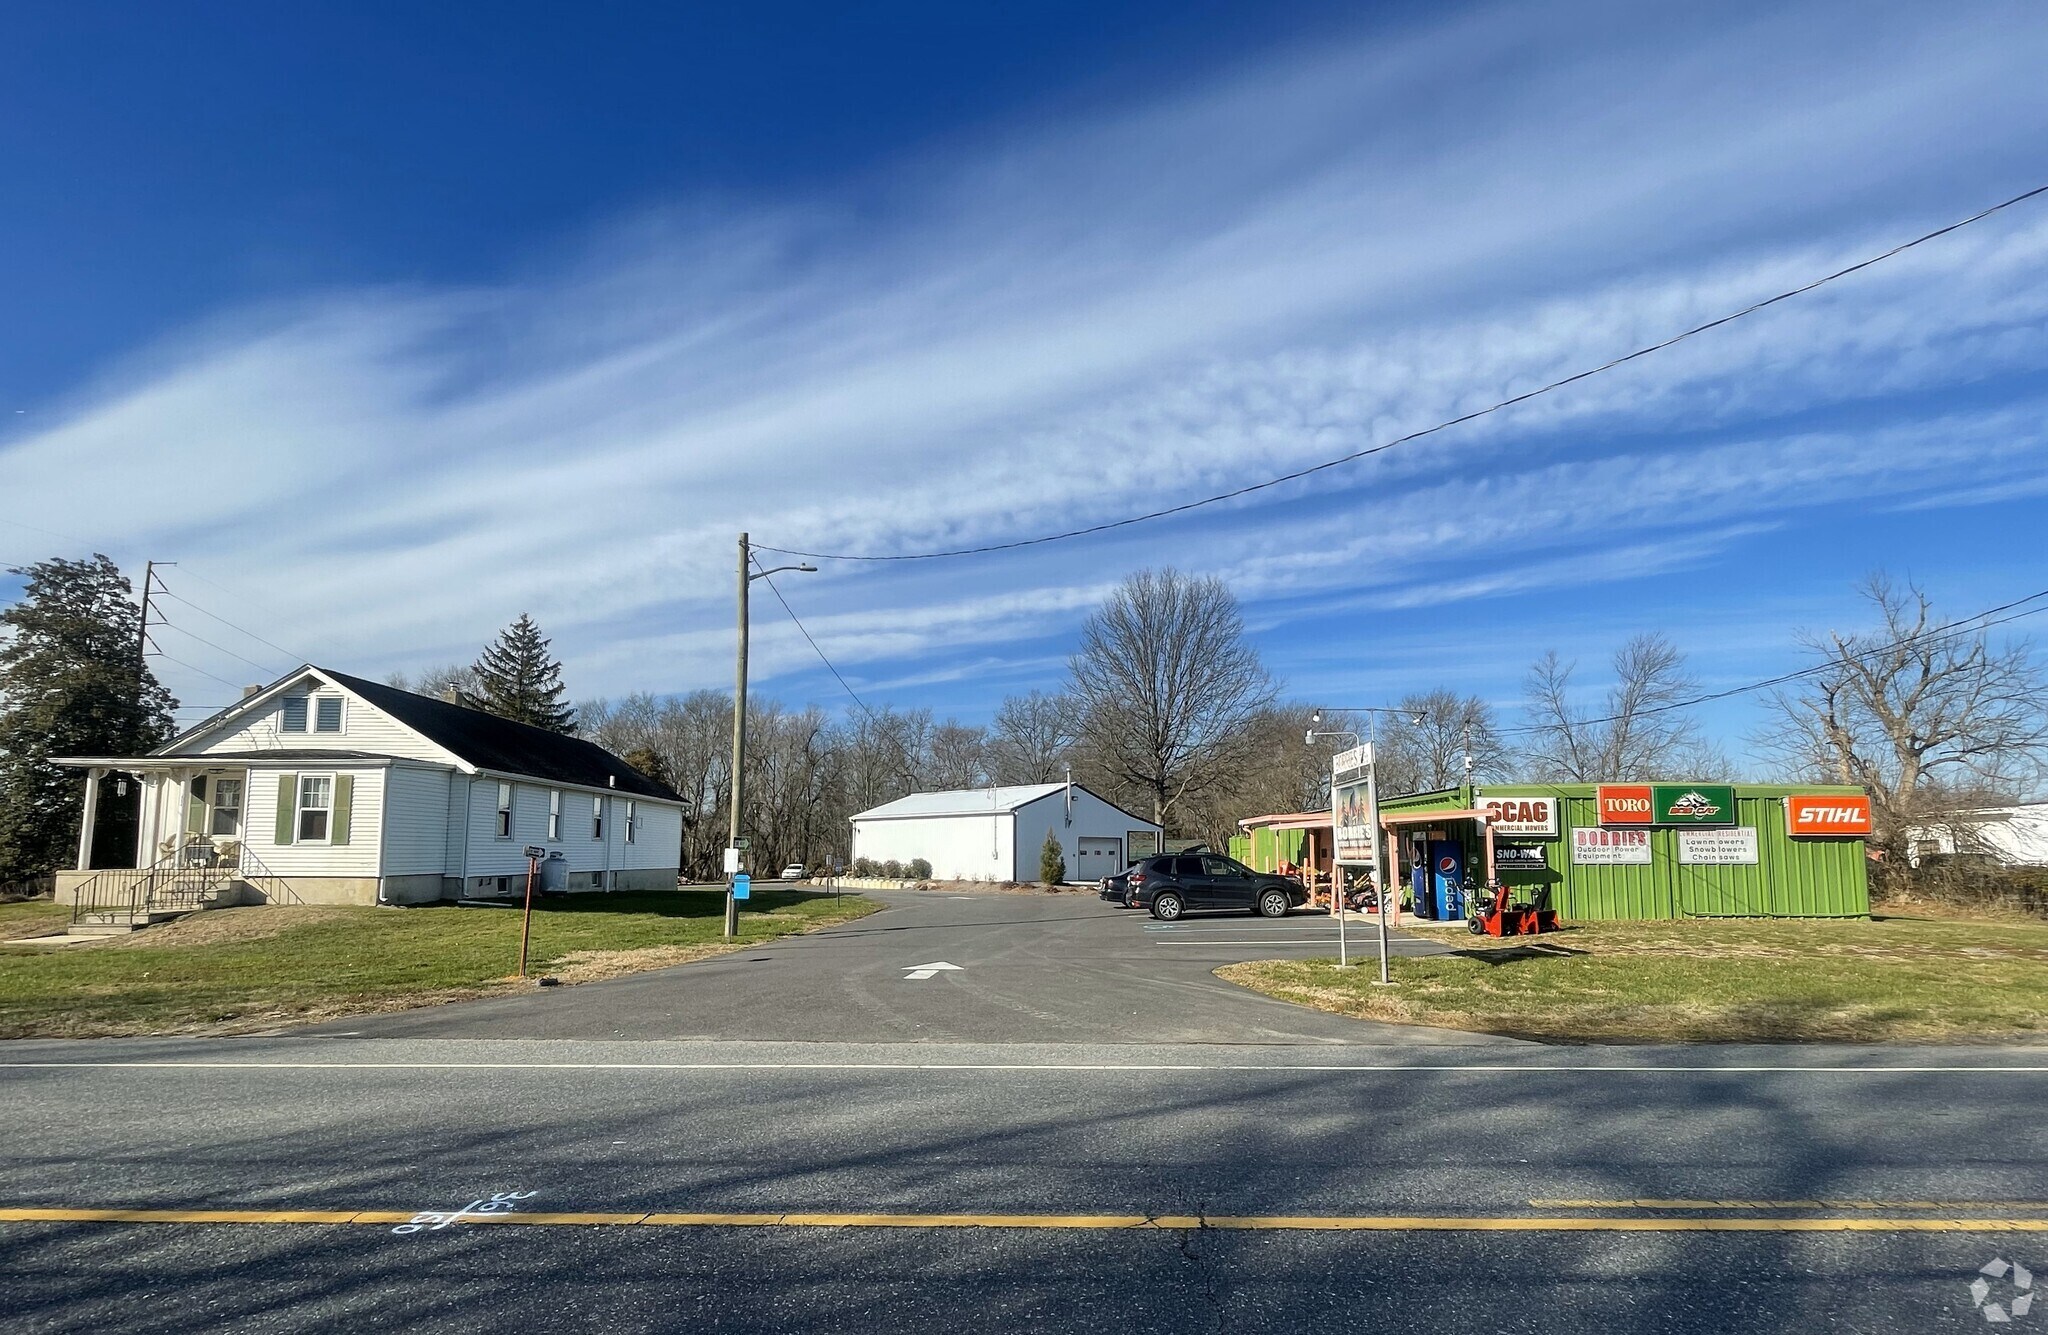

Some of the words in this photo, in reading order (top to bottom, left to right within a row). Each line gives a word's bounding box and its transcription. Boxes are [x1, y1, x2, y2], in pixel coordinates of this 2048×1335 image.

[1486, 801, 1548, 823] SCAG
[1604, 798, 1650, 813] TORO
[1797, 807, 1866, 823] STIHL
[1490, 824, 1524, 832] OMMERCIAL
[1524, 824, 1549, 832] MOWERS
[1445, 876, 1456, 911] pepsi
